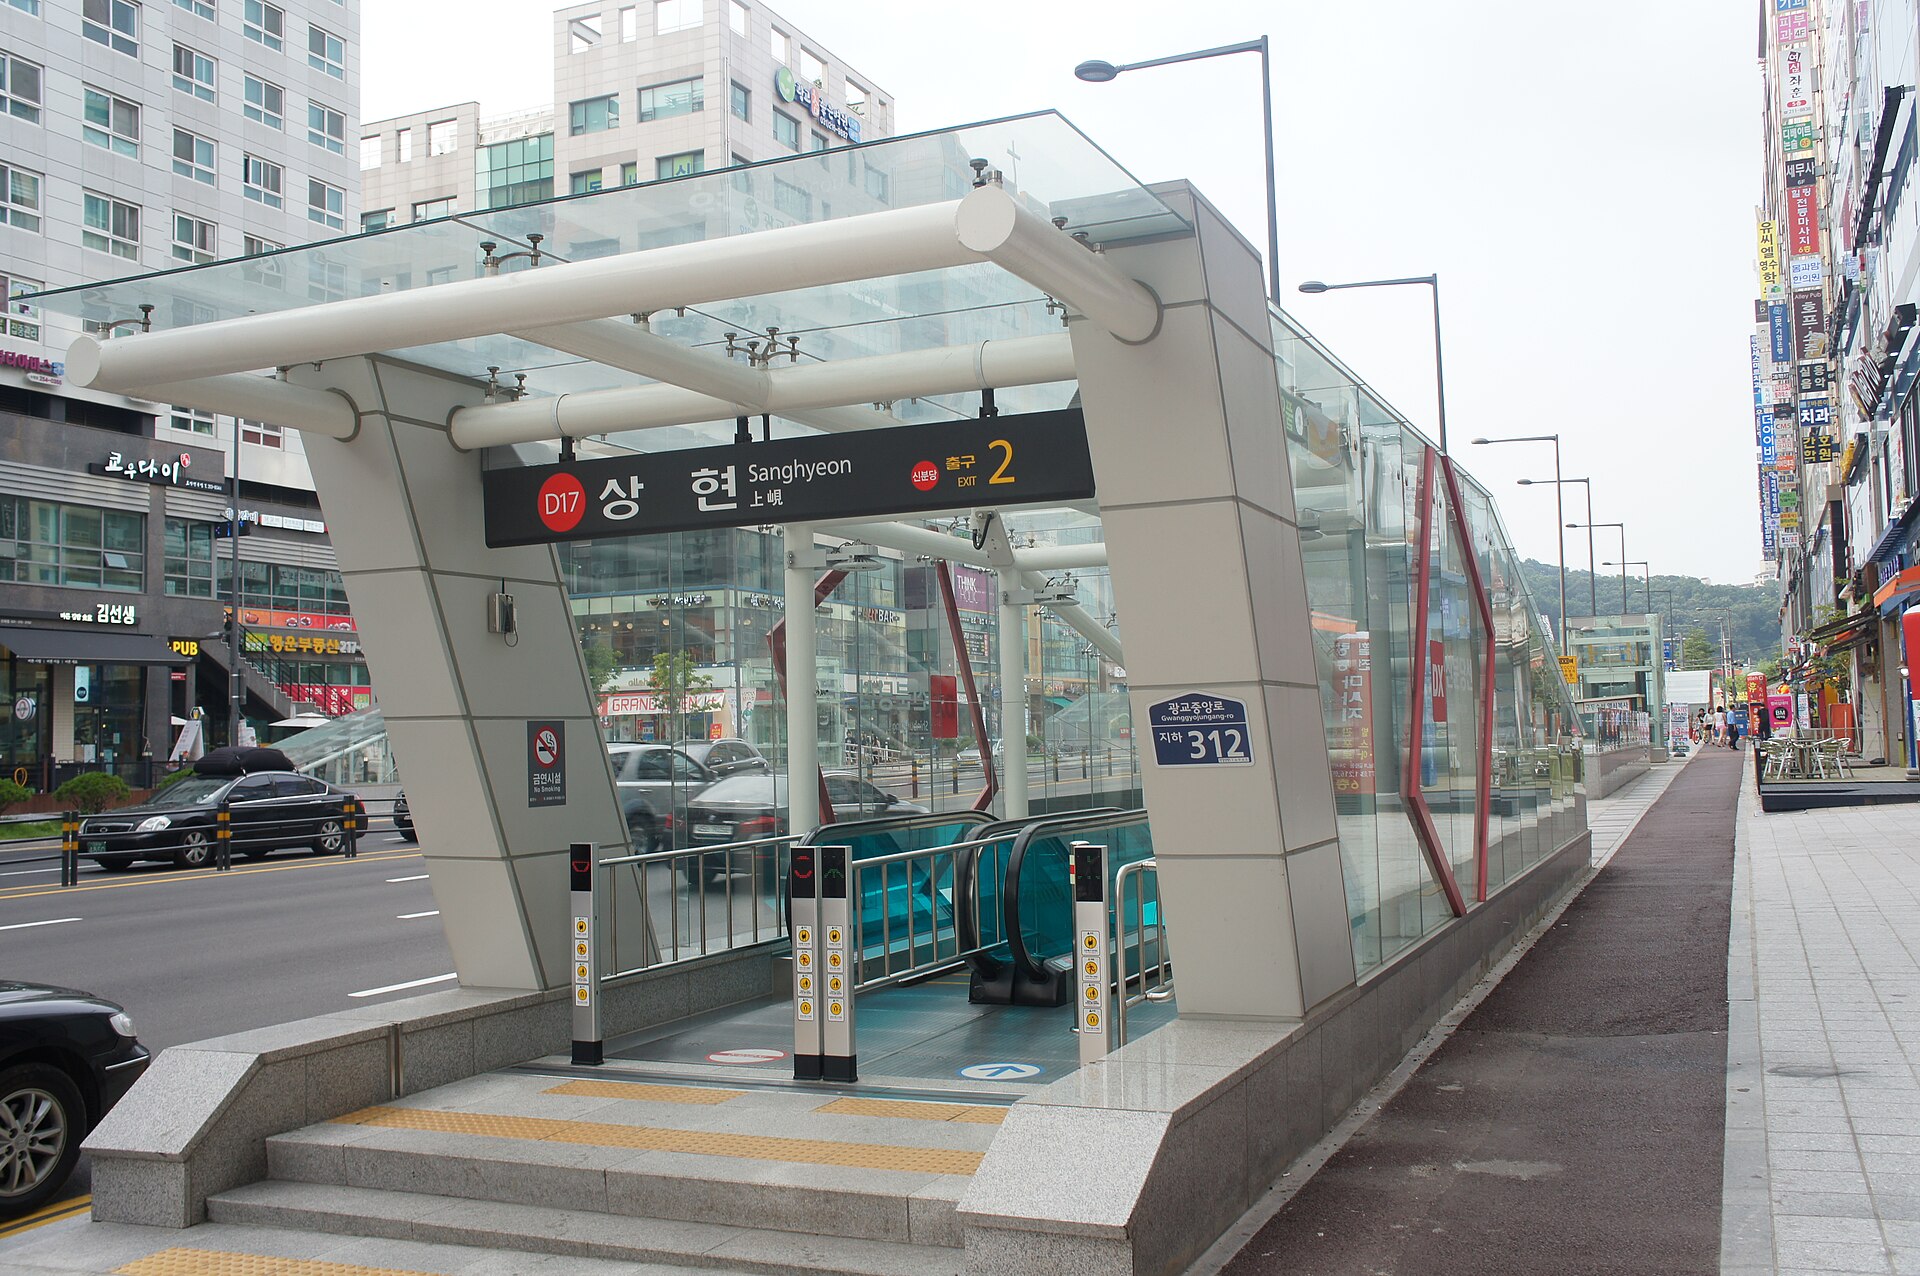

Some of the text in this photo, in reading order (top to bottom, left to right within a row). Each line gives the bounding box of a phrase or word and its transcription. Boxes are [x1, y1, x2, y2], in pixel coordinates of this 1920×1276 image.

[1786, 161, 1815, 178] 세무사
[1793, 272, 1821, 285] 한의원
[1794, 291, 1822, 301] Alley Pub
[1801, 407, 1830, 424] 치과
[1775, 422, 1791, 430] CMS
[1803, 434, 1831, 449] 간호
[945, 439, 1015, 485] 출구 2
[1804, 448, 1832, 463] 학원
[748, 458, 852, 484] Sanghyeon
[912, 469, 938, 482] 신분당
[957, 476, 977, 488] EXIT
[598, 464, 738, 520] 상 현
[545, 491, 580, 515] D17
[956, 575, 977, 592] THINK
[97, 603, 136, 625] 김선생
[878, 609, 894, 623] BAR
[173, 641, 199, 655] PUB
[269, 634, 340, 654] 행운부동산
[1432, 663, 1444, 697] DX
[1168, 700, 1225, 715] 광교중앙로
[1161, 713, 1235, 723] Gwanggyojungang-ro
[1159, 729, 1245, 759] 지하 312
[533, 772, 561, 786] 금연시설
[541, 785, 561, 793] Smoking
